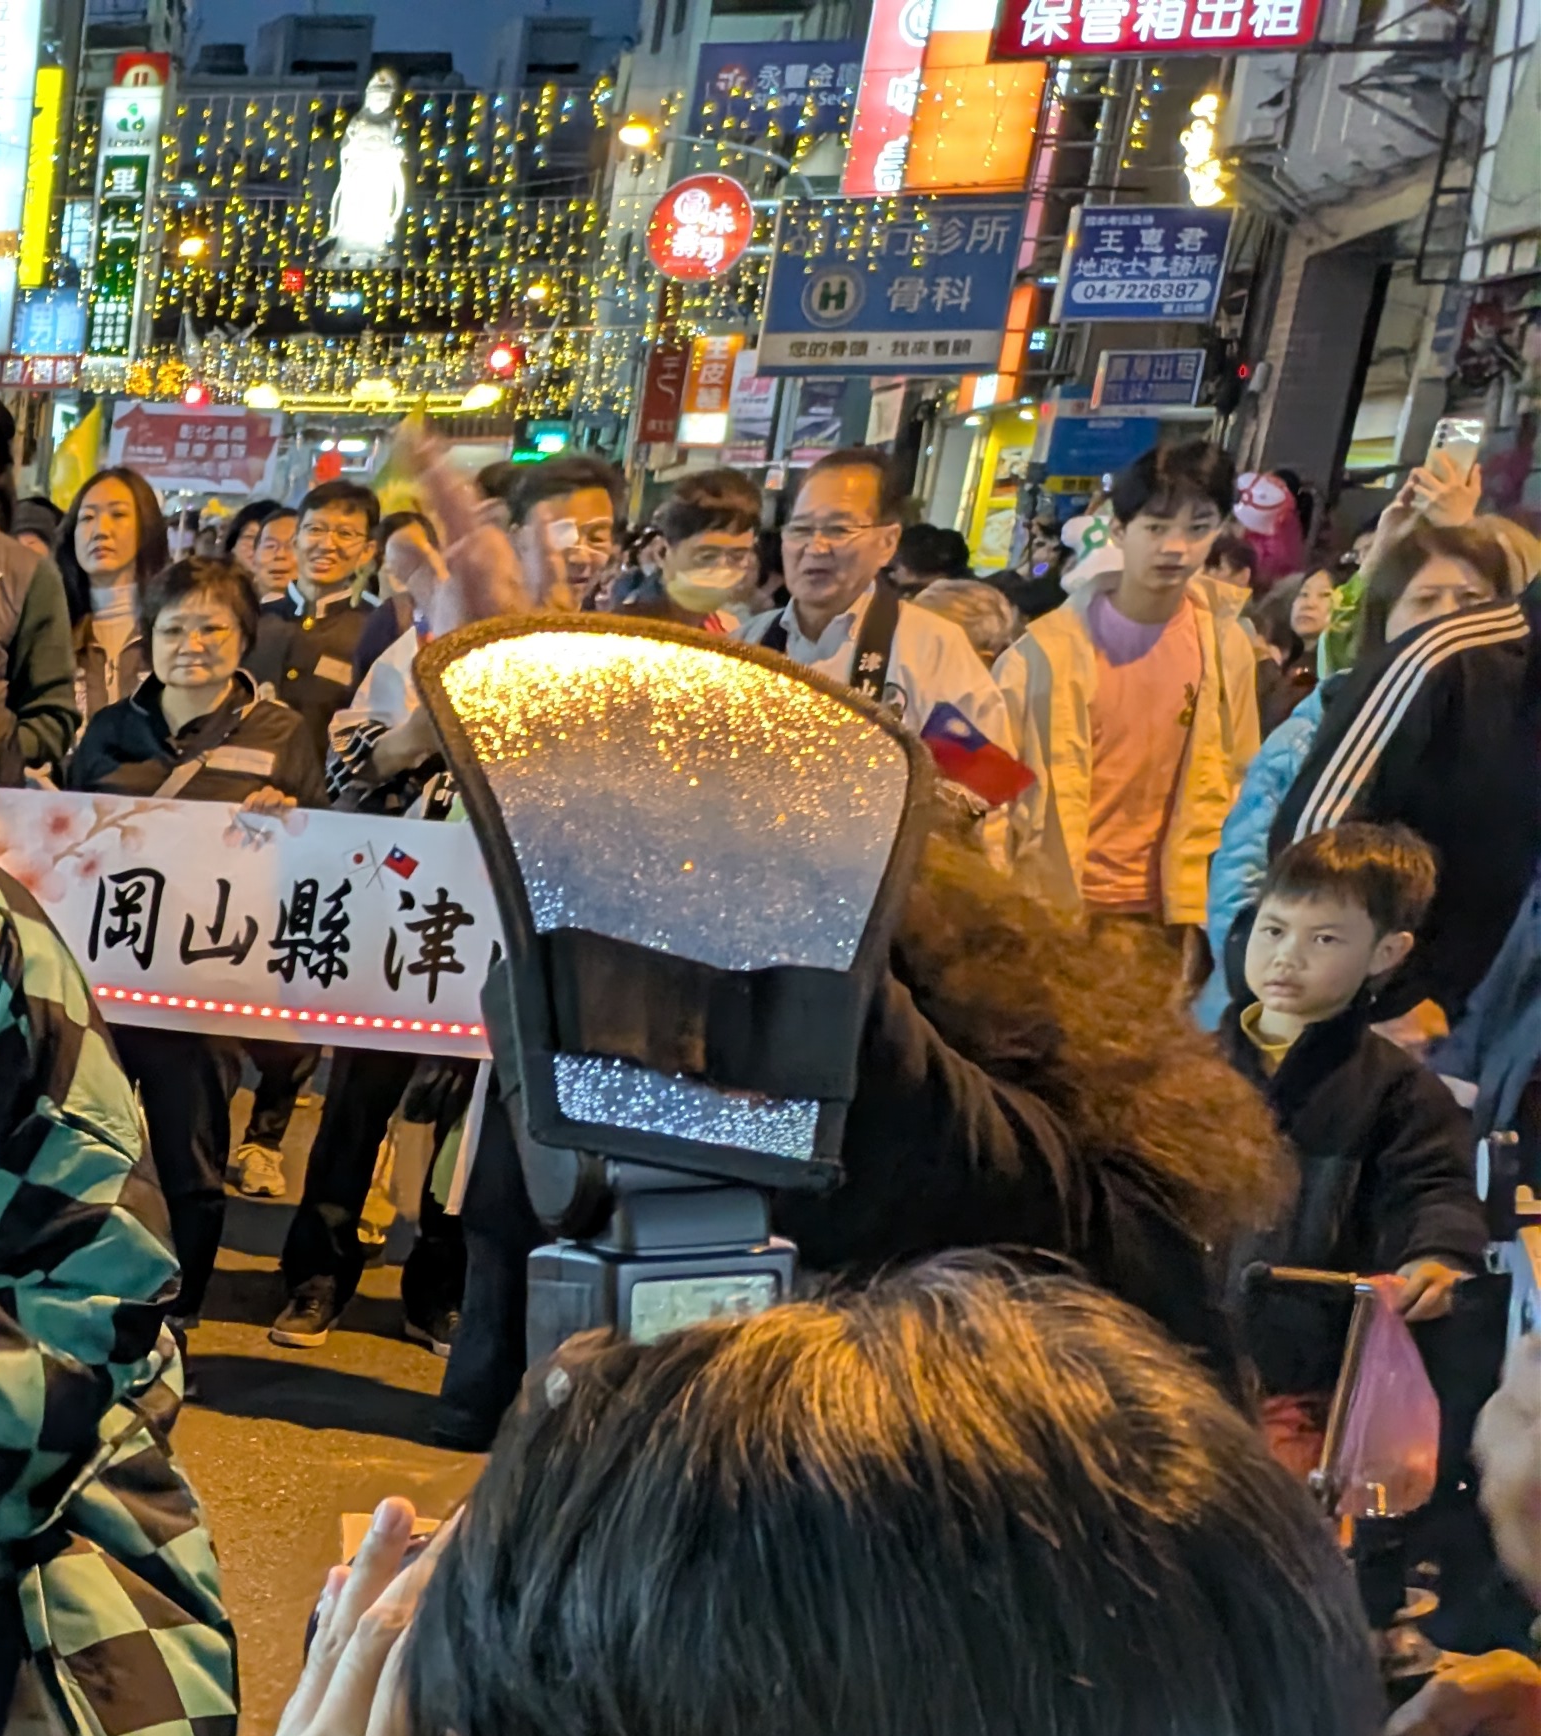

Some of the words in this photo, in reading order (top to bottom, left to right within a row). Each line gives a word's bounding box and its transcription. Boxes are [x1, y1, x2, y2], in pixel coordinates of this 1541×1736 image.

[100, 166, 143, 244] 里仁
[1073, 254, 1218, 279] 地政士事務所
[887, 275, 972, 314] 骨科
[1083, 282, 1199, 300] 04-7226387
[88, 866, 504, 1005] 岡山縣津
